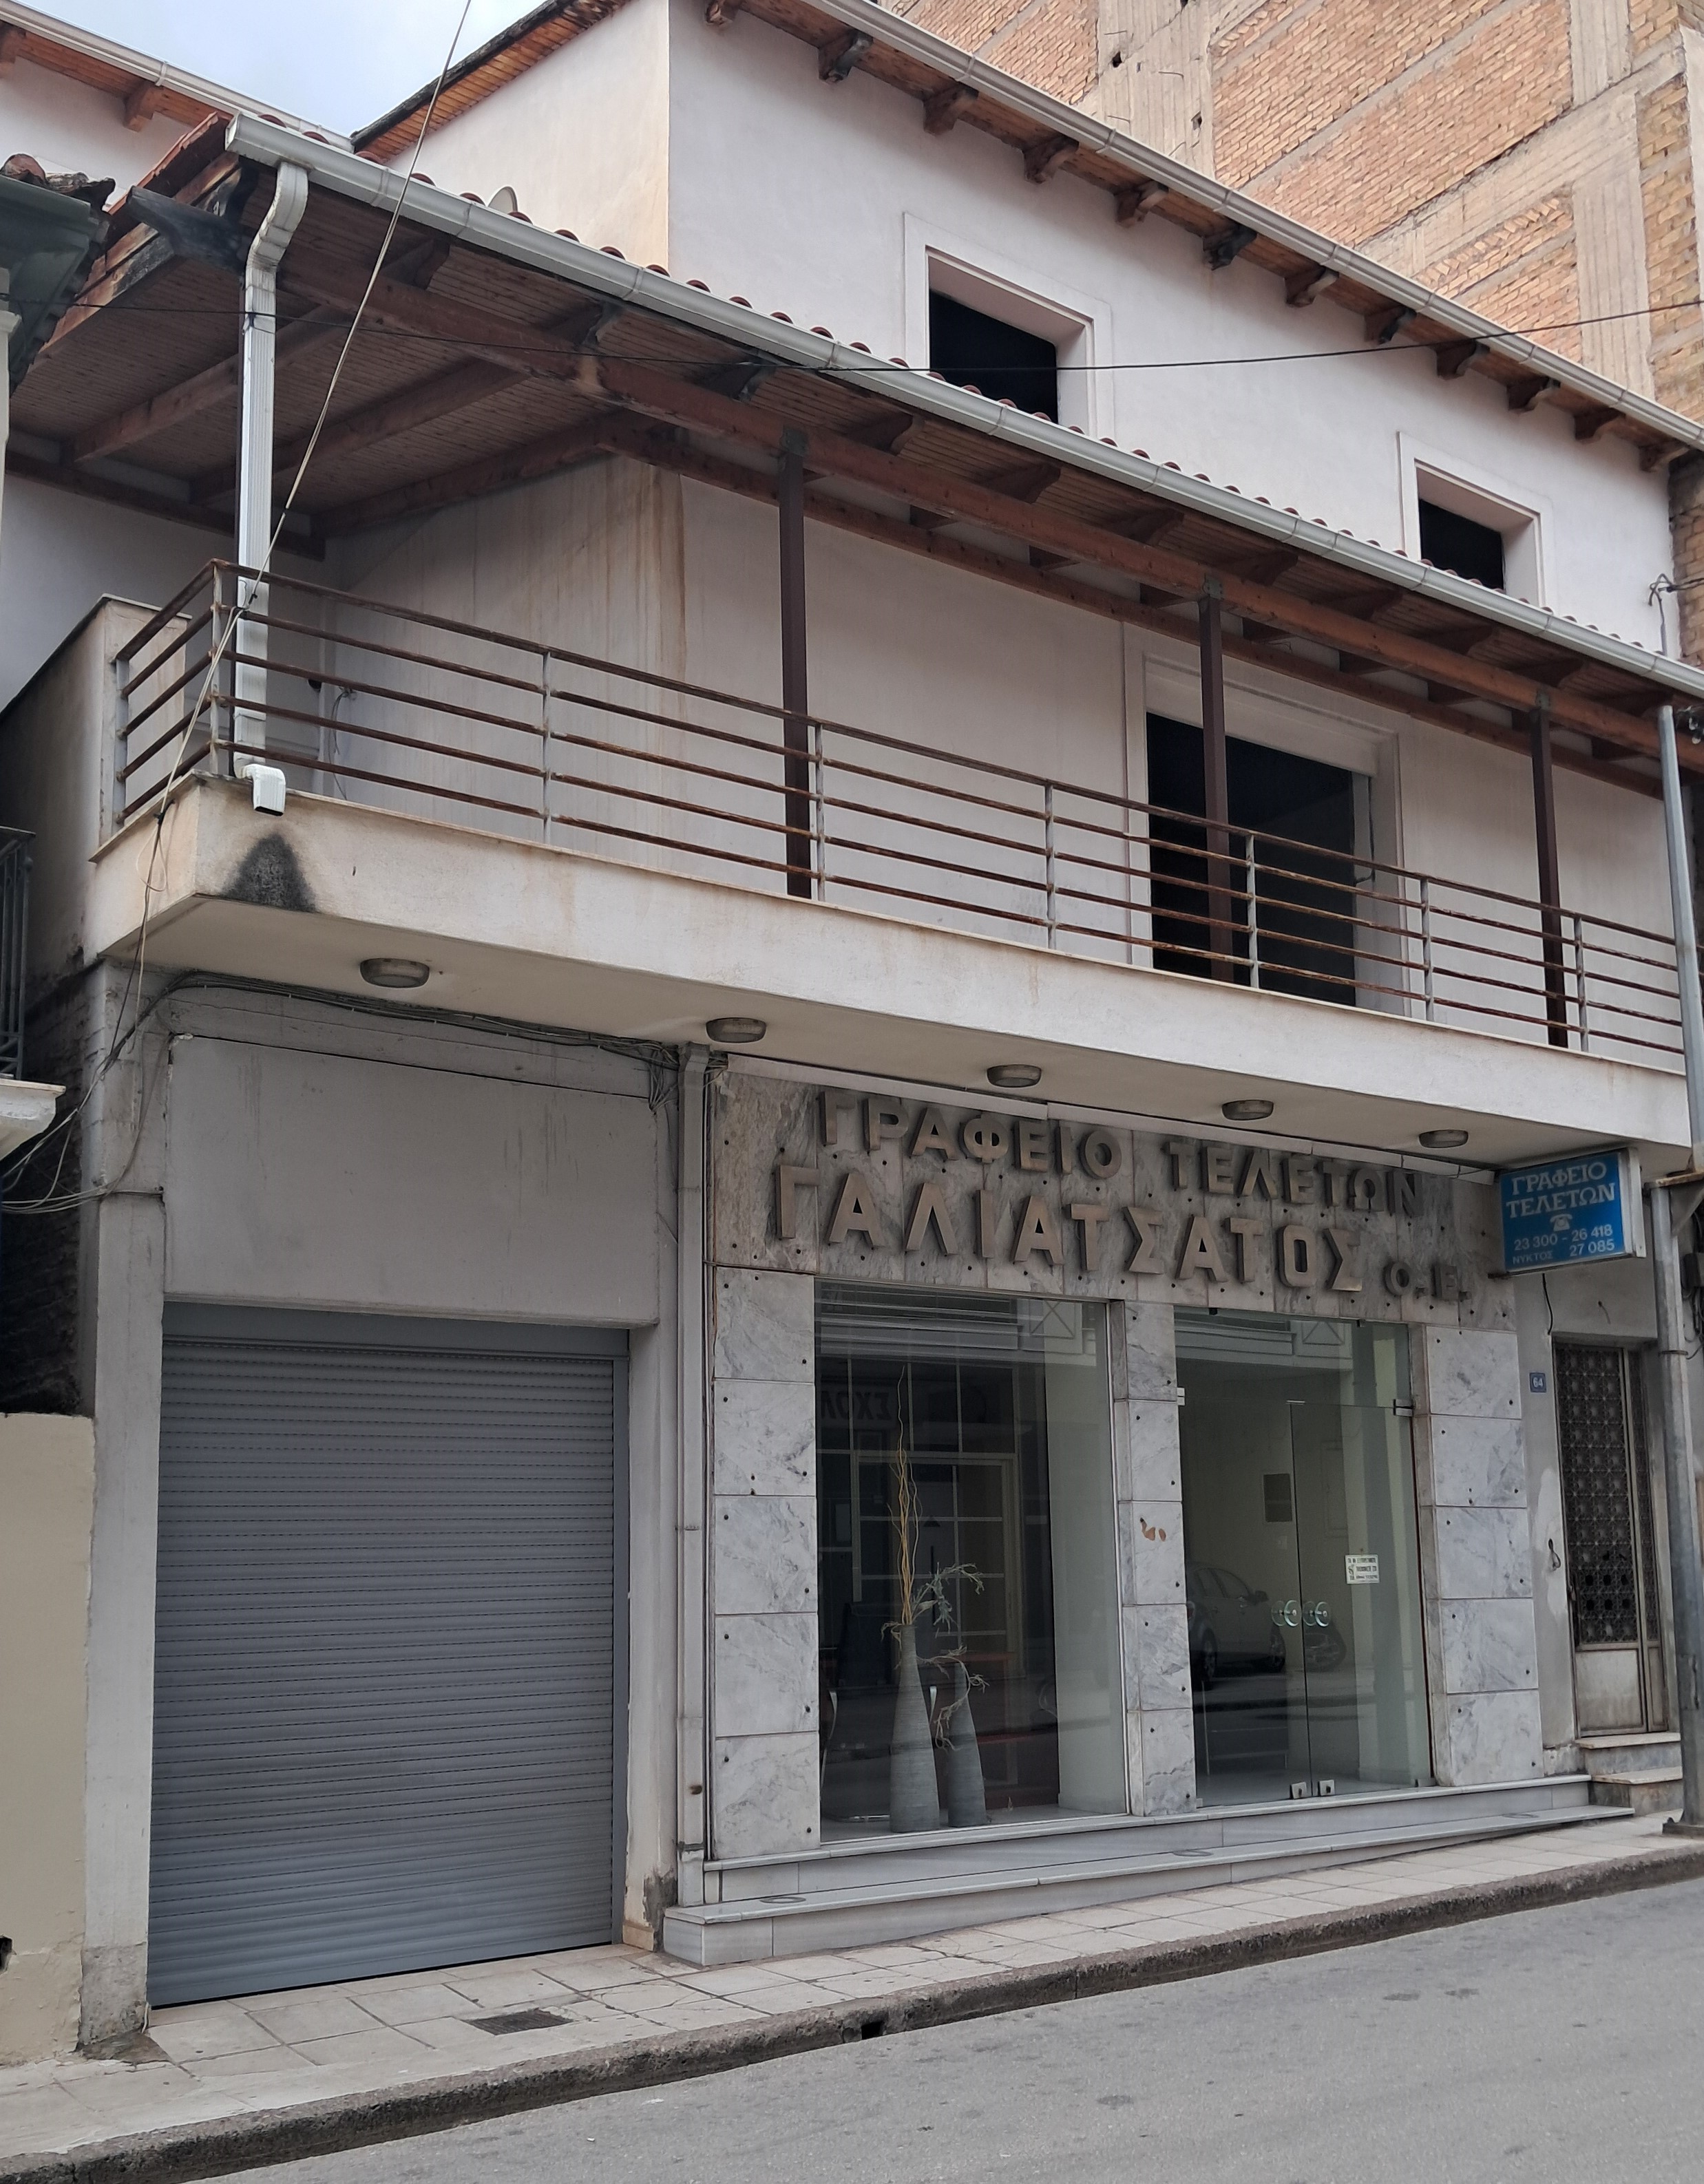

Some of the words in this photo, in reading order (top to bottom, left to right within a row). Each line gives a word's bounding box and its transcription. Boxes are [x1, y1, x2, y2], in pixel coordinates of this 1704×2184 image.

[821, 1090, 1122, 1180] ΓΡΑΦΕΙΟ
[1164, 1141, 1423, 1217] ΤΕΛΕΤΩΝ
[1511, 1161, 1607, 1196] ΓΡΑΦΕΙΟ
[1506, 1183, 1615, 1218] ΤΕΛΕΤΩΝ
[775, 1163, 1363, 1291] ΓΑΛΙΑΤΣΑΤΟΣ
[1515, 1238, 1530, 1251] 23
[1533, 1233, 1558, 1248] 300
[1571, 1228, 1588, 1242] 26
[1590, 1224, 1613, 1238] 418
[1513, 1250, 1554, 1265] ΝΥΚΤΟΣ
[1570, 1243, 1585, 1257] 27
[1588, 1239, 1615, 1253] 085
[1533, 1377, 1544, 1388] 64
